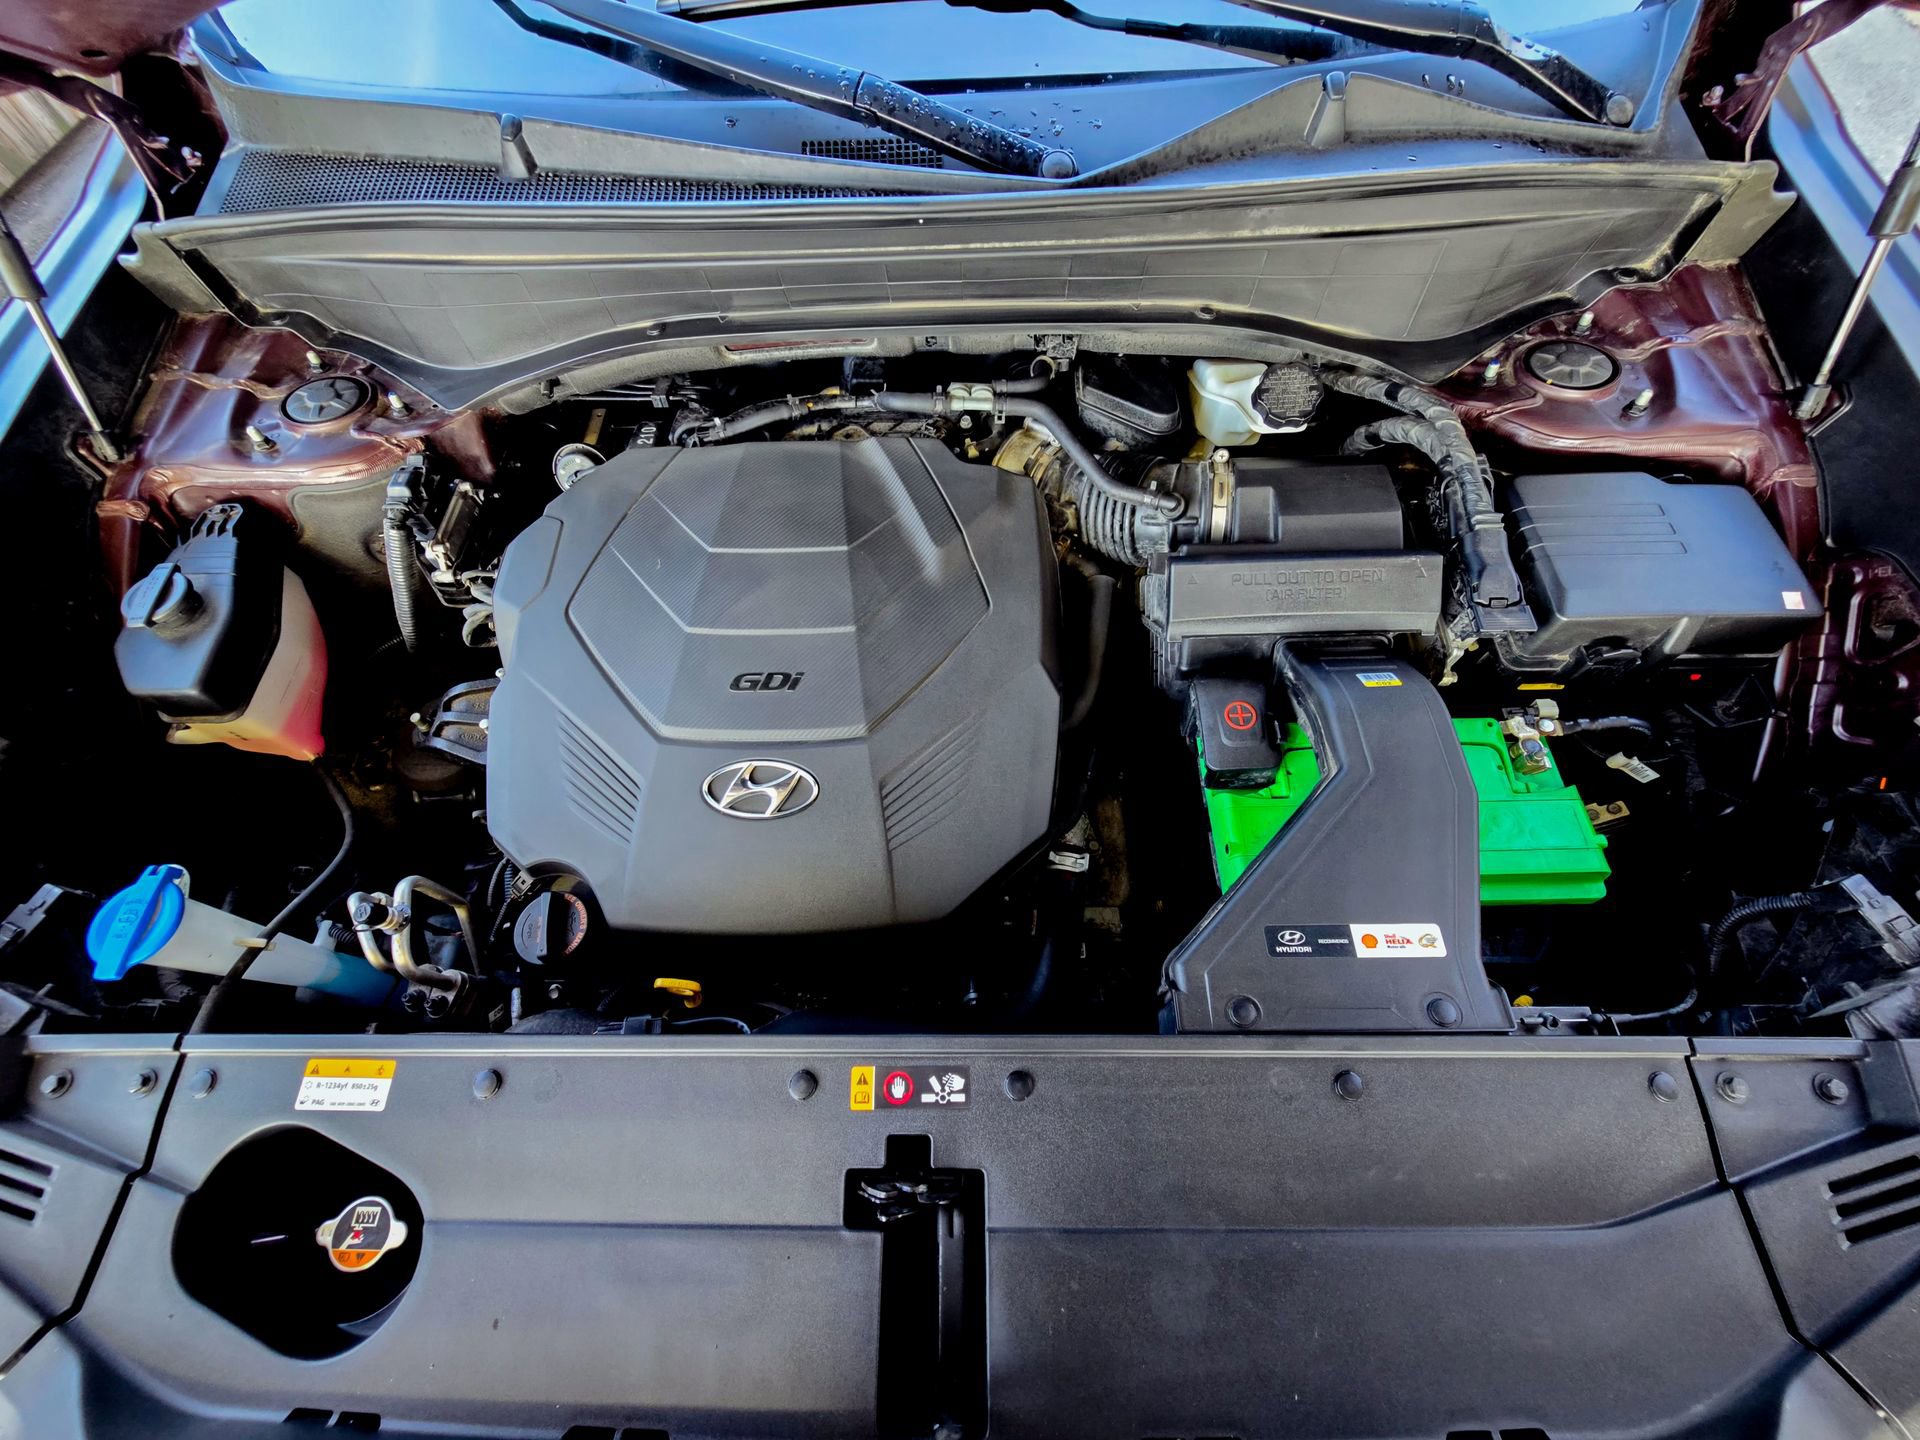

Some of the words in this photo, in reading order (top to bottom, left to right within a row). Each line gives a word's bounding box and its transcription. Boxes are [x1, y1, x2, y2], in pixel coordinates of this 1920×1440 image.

[637, 426, 657, 445] 210
[1231, 572, 1272, 586] PULL
[1276, 570, 1310, 585] OUT
[1313, 569, 1335, 584] TO
[1339, 568, 1384, 583] OPEN
[729, 672, 805, 692] GDi
[1385, 937, 1413, 945] HELIX
